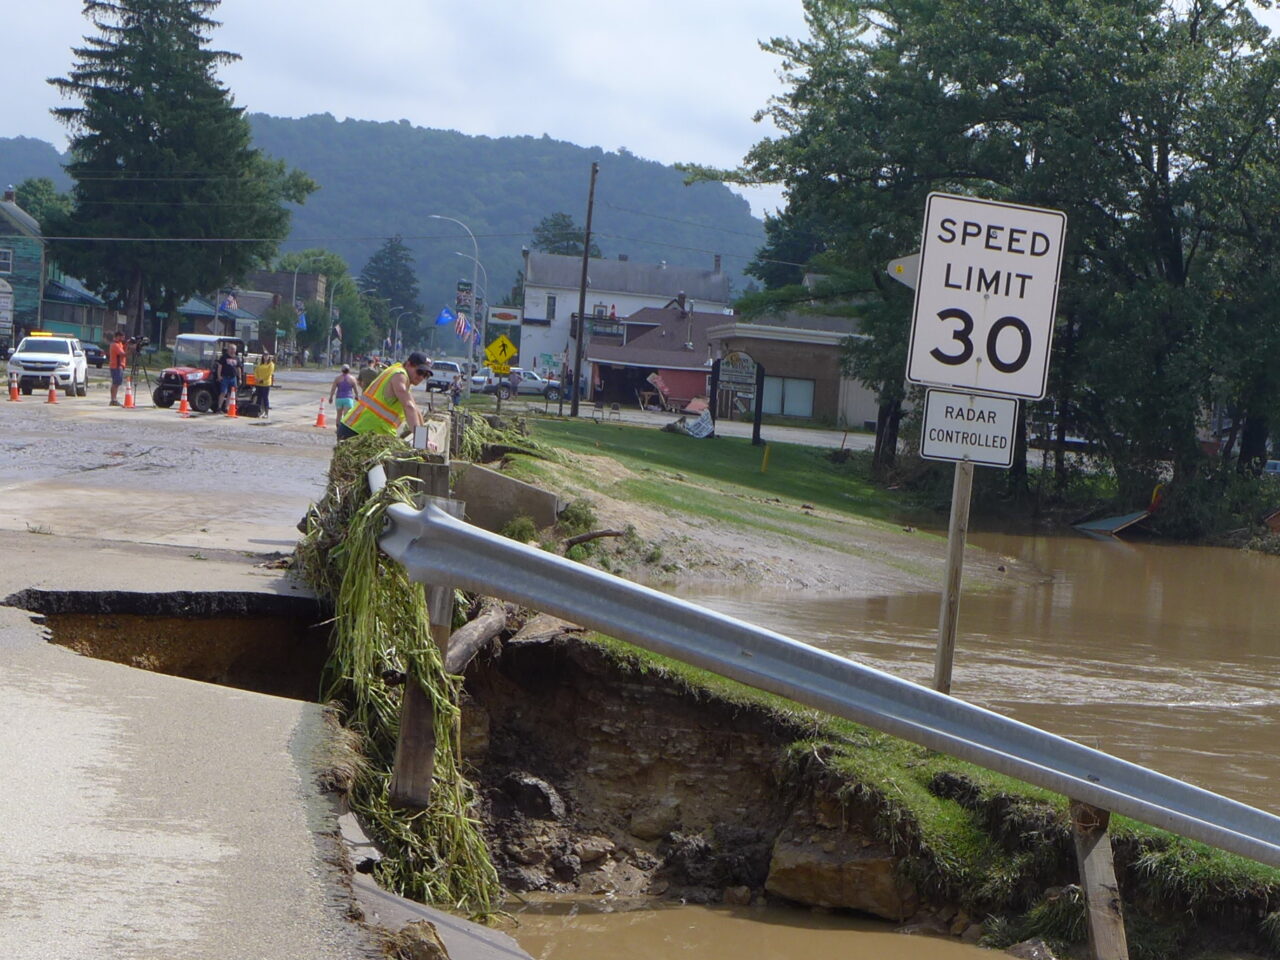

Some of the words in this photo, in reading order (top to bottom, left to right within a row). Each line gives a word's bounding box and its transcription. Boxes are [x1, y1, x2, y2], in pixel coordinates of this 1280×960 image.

[937, 218, 1051, 257] SPEED
[944, 263, 1033, 299] LIMIT
[929, 308, 1032, 374] 30
[944, 405, 997, 424] RADAR
[928, 428, 1008, 449] CONTROLLED
